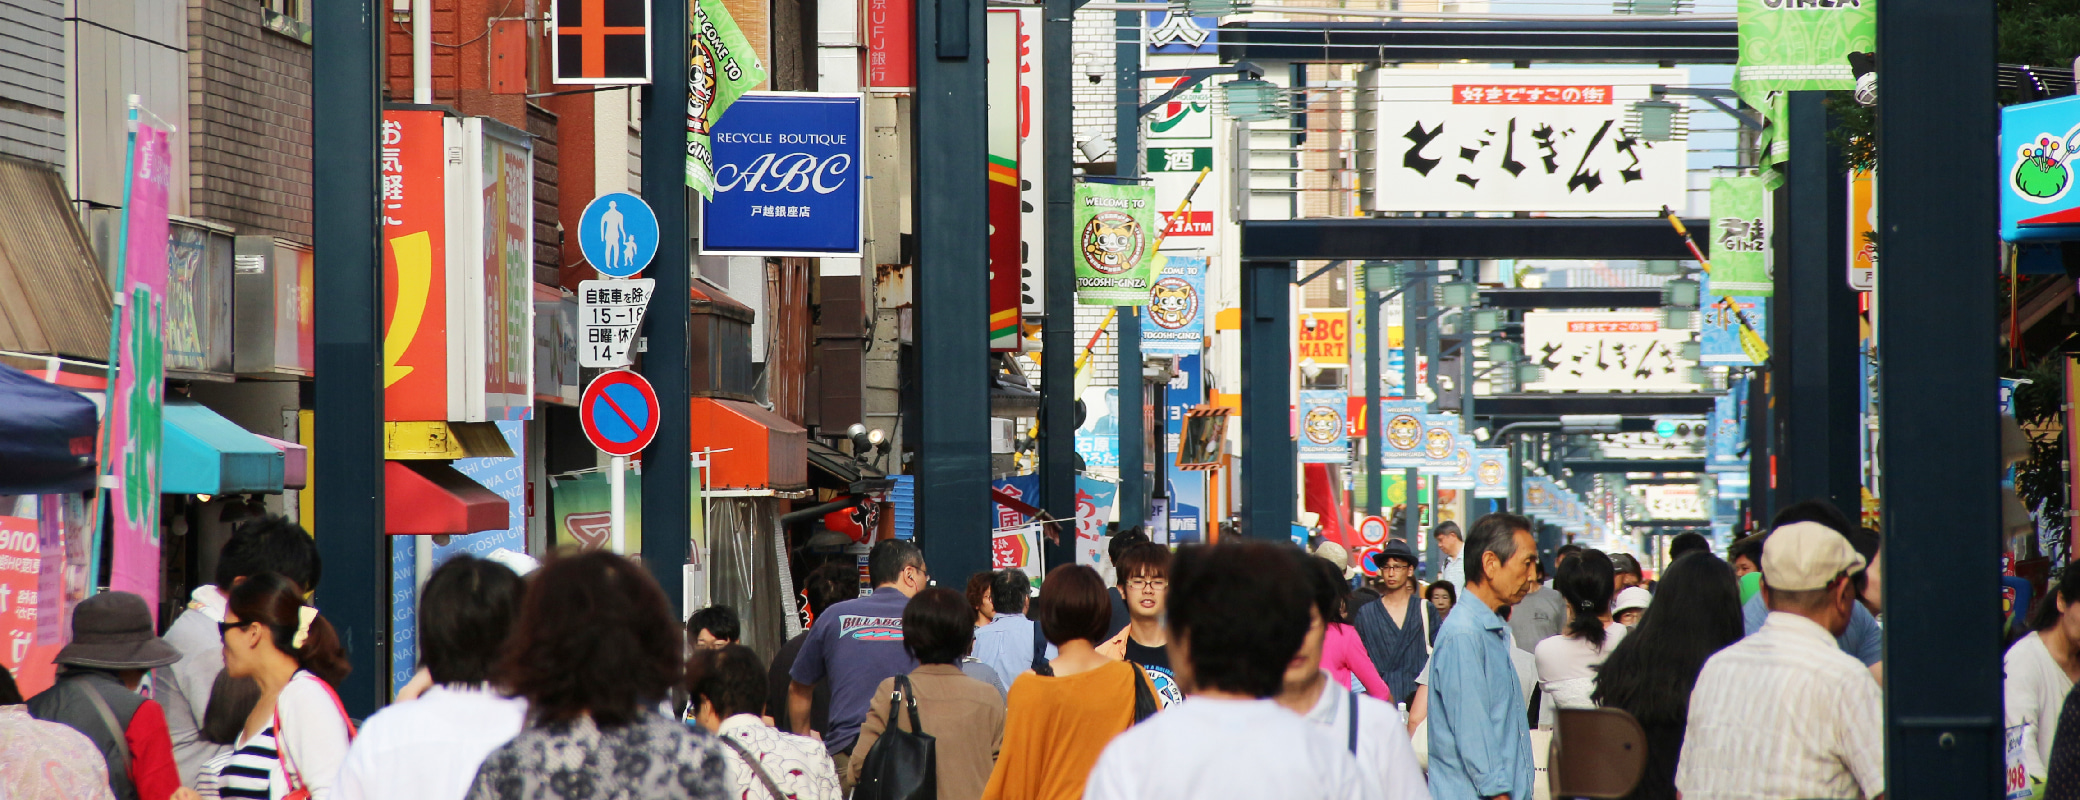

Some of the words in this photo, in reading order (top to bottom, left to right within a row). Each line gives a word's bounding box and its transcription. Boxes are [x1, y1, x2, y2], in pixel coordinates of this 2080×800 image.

[723, 57, 742, 81] TO
[1460, 86, 1605, 103] 好きですこの街
[717, 133, 772, 144] RECYCLE
[779, 133, 847, 146] BOUTIQUE
[1164, 148, 1195, 171] 酒
[1402, 116, 1653, 194] とごしぎんざ
[714, 152, 851, 194] ABC
[1085, 196, 1129, 208] WELCOME
[1132, 199, 1146, 208] TO
[751, 205, 811, 218] 戸越銀座店
[1187, 267, 1198, 275] TO
[1078, 277, 1147, 289] TOGOSHI-GINZA
[1142, 331, 1200, 340] TOGOSHI-GINZA
[1299, 319, 1345, 341] ABC
[1299, 343, 1345, 357] MART
[1366, 524, 1381, 537] 30
